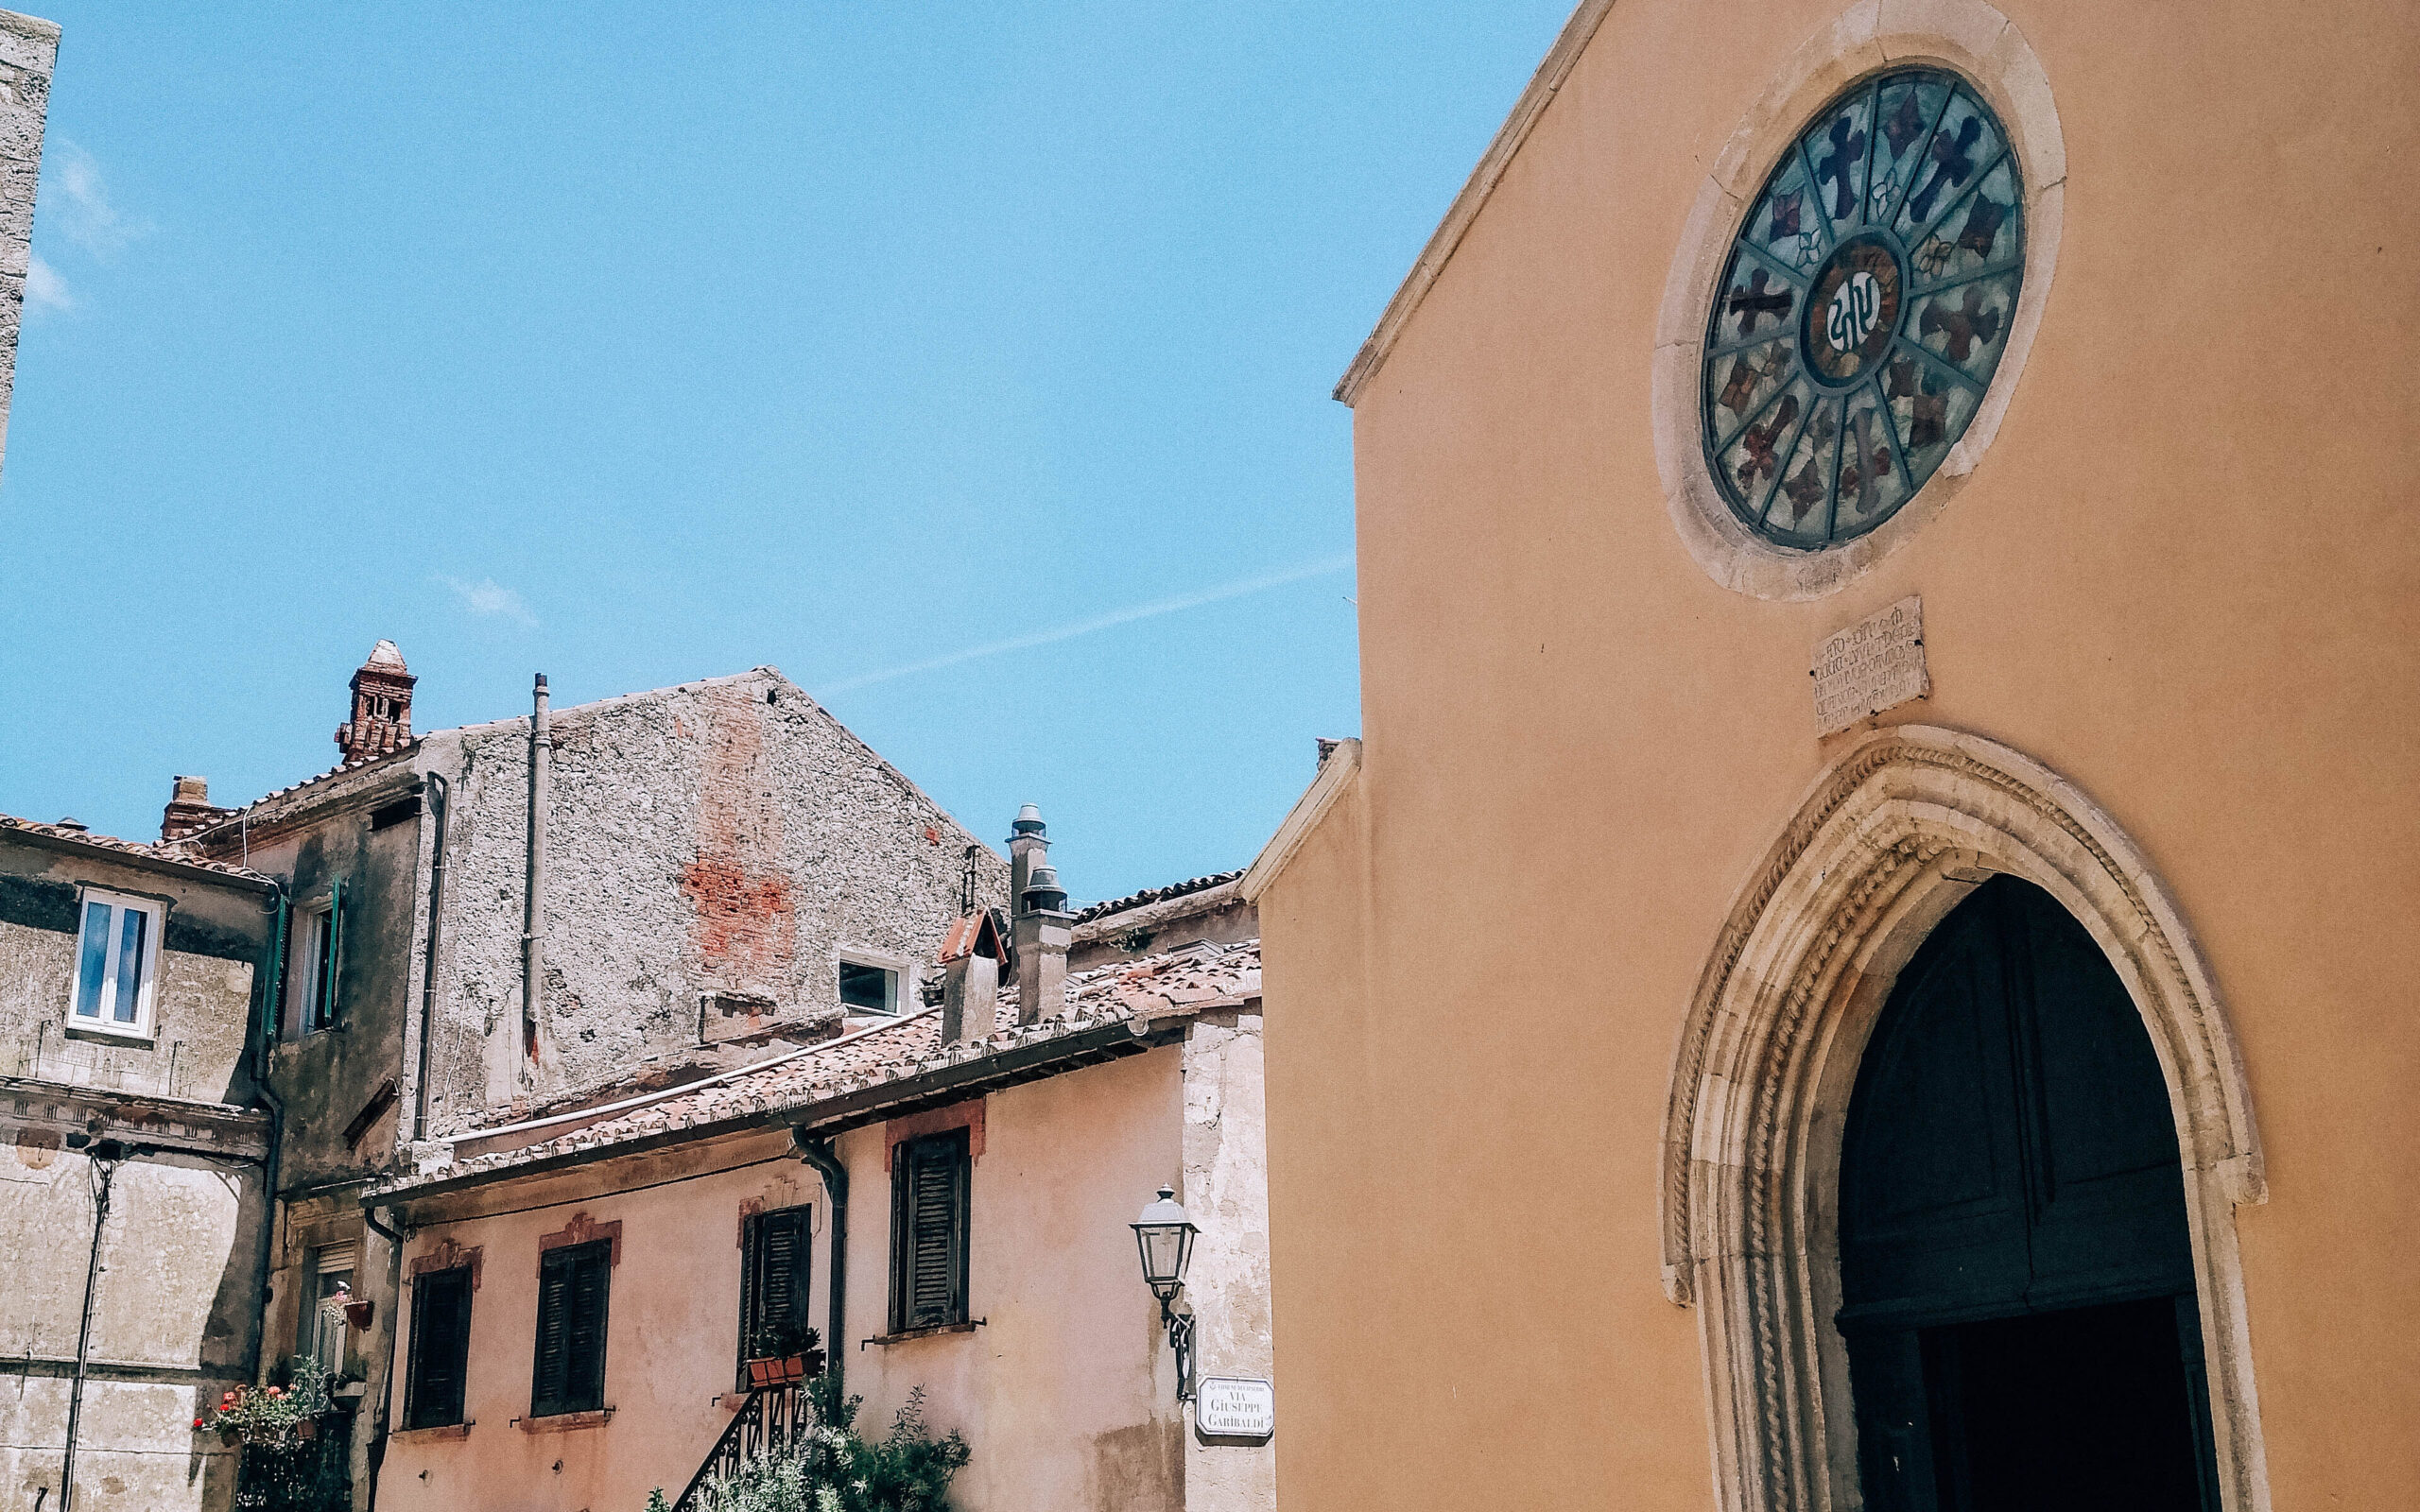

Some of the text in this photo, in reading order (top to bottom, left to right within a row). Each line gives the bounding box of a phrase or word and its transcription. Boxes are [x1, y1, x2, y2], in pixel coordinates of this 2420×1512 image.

[1230, 1391, 1246, 1401] VIA
[1211, 1399, 1263, 1413] GIUSEPPE
[1208, 1413, 1264, 1429] GARIBALDI
